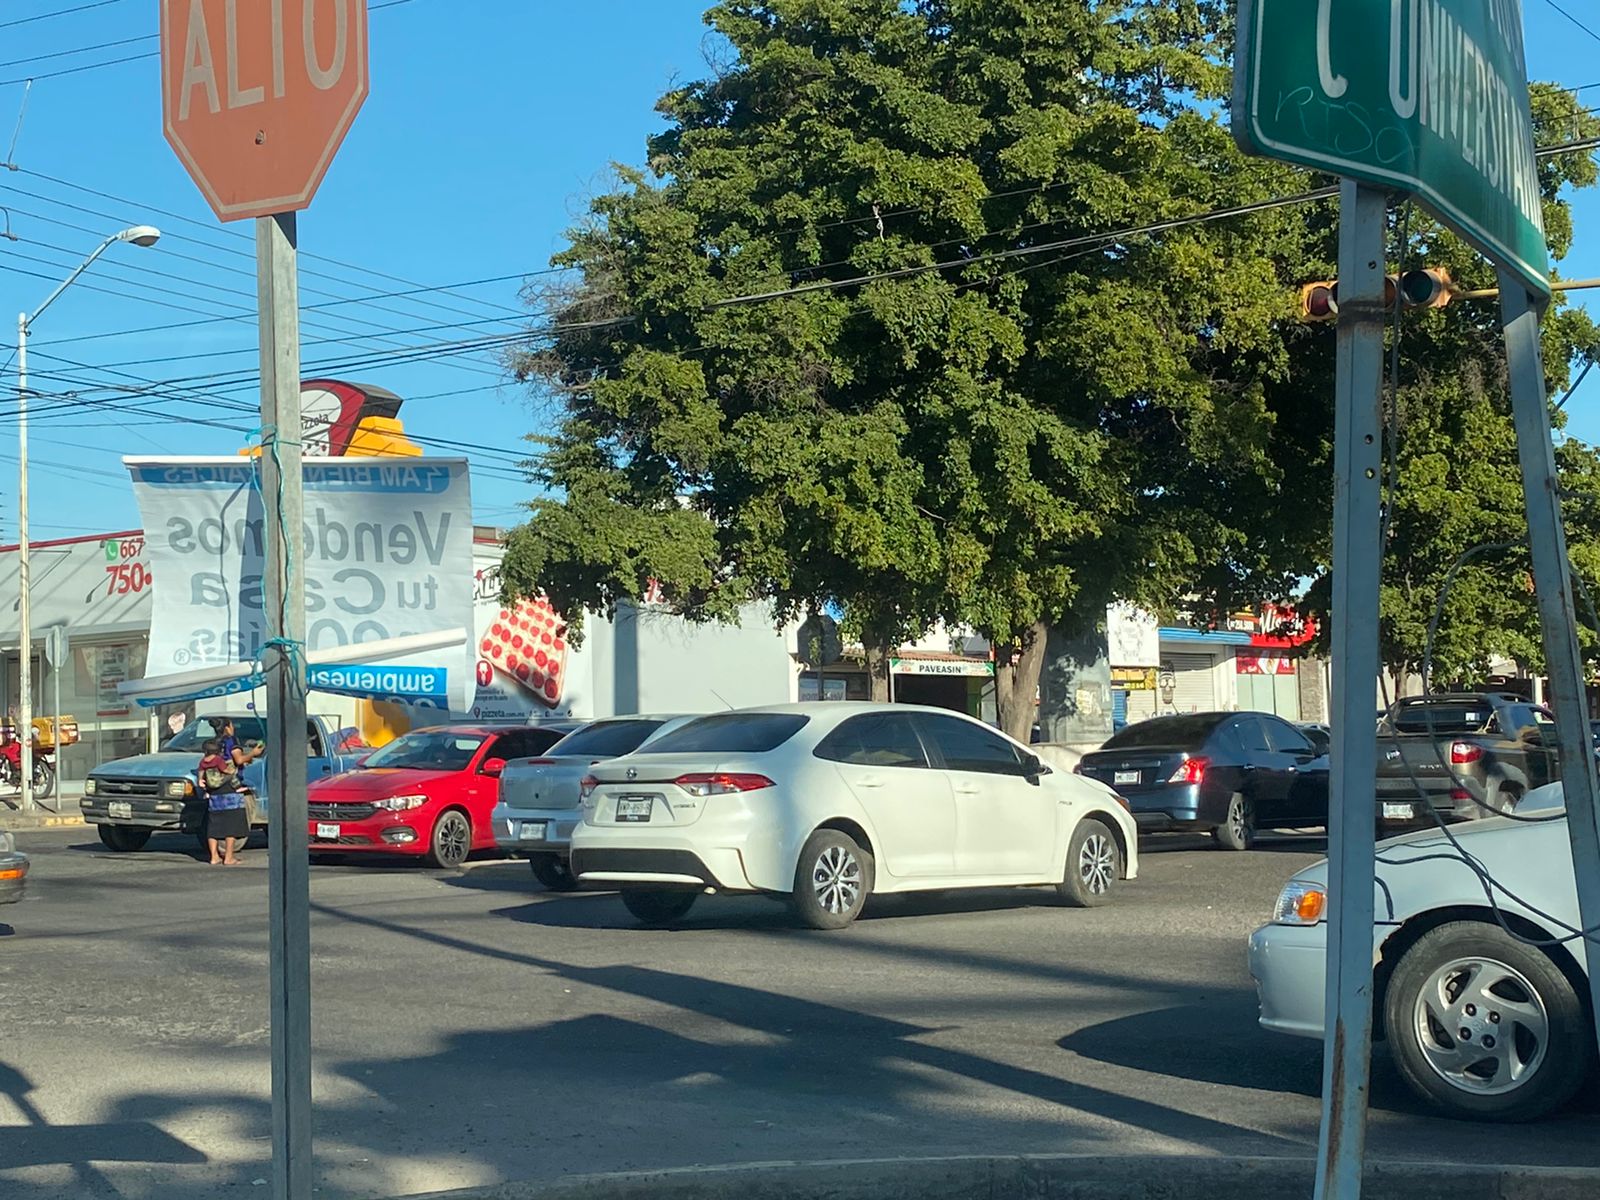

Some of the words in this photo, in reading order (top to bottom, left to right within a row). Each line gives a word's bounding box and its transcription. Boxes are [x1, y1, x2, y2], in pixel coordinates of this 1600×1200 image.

[178, 0, 349, 121] ALTO
[120, 538, 144, 558] 667
[918, 664, 962, 674] PAVEASIN
